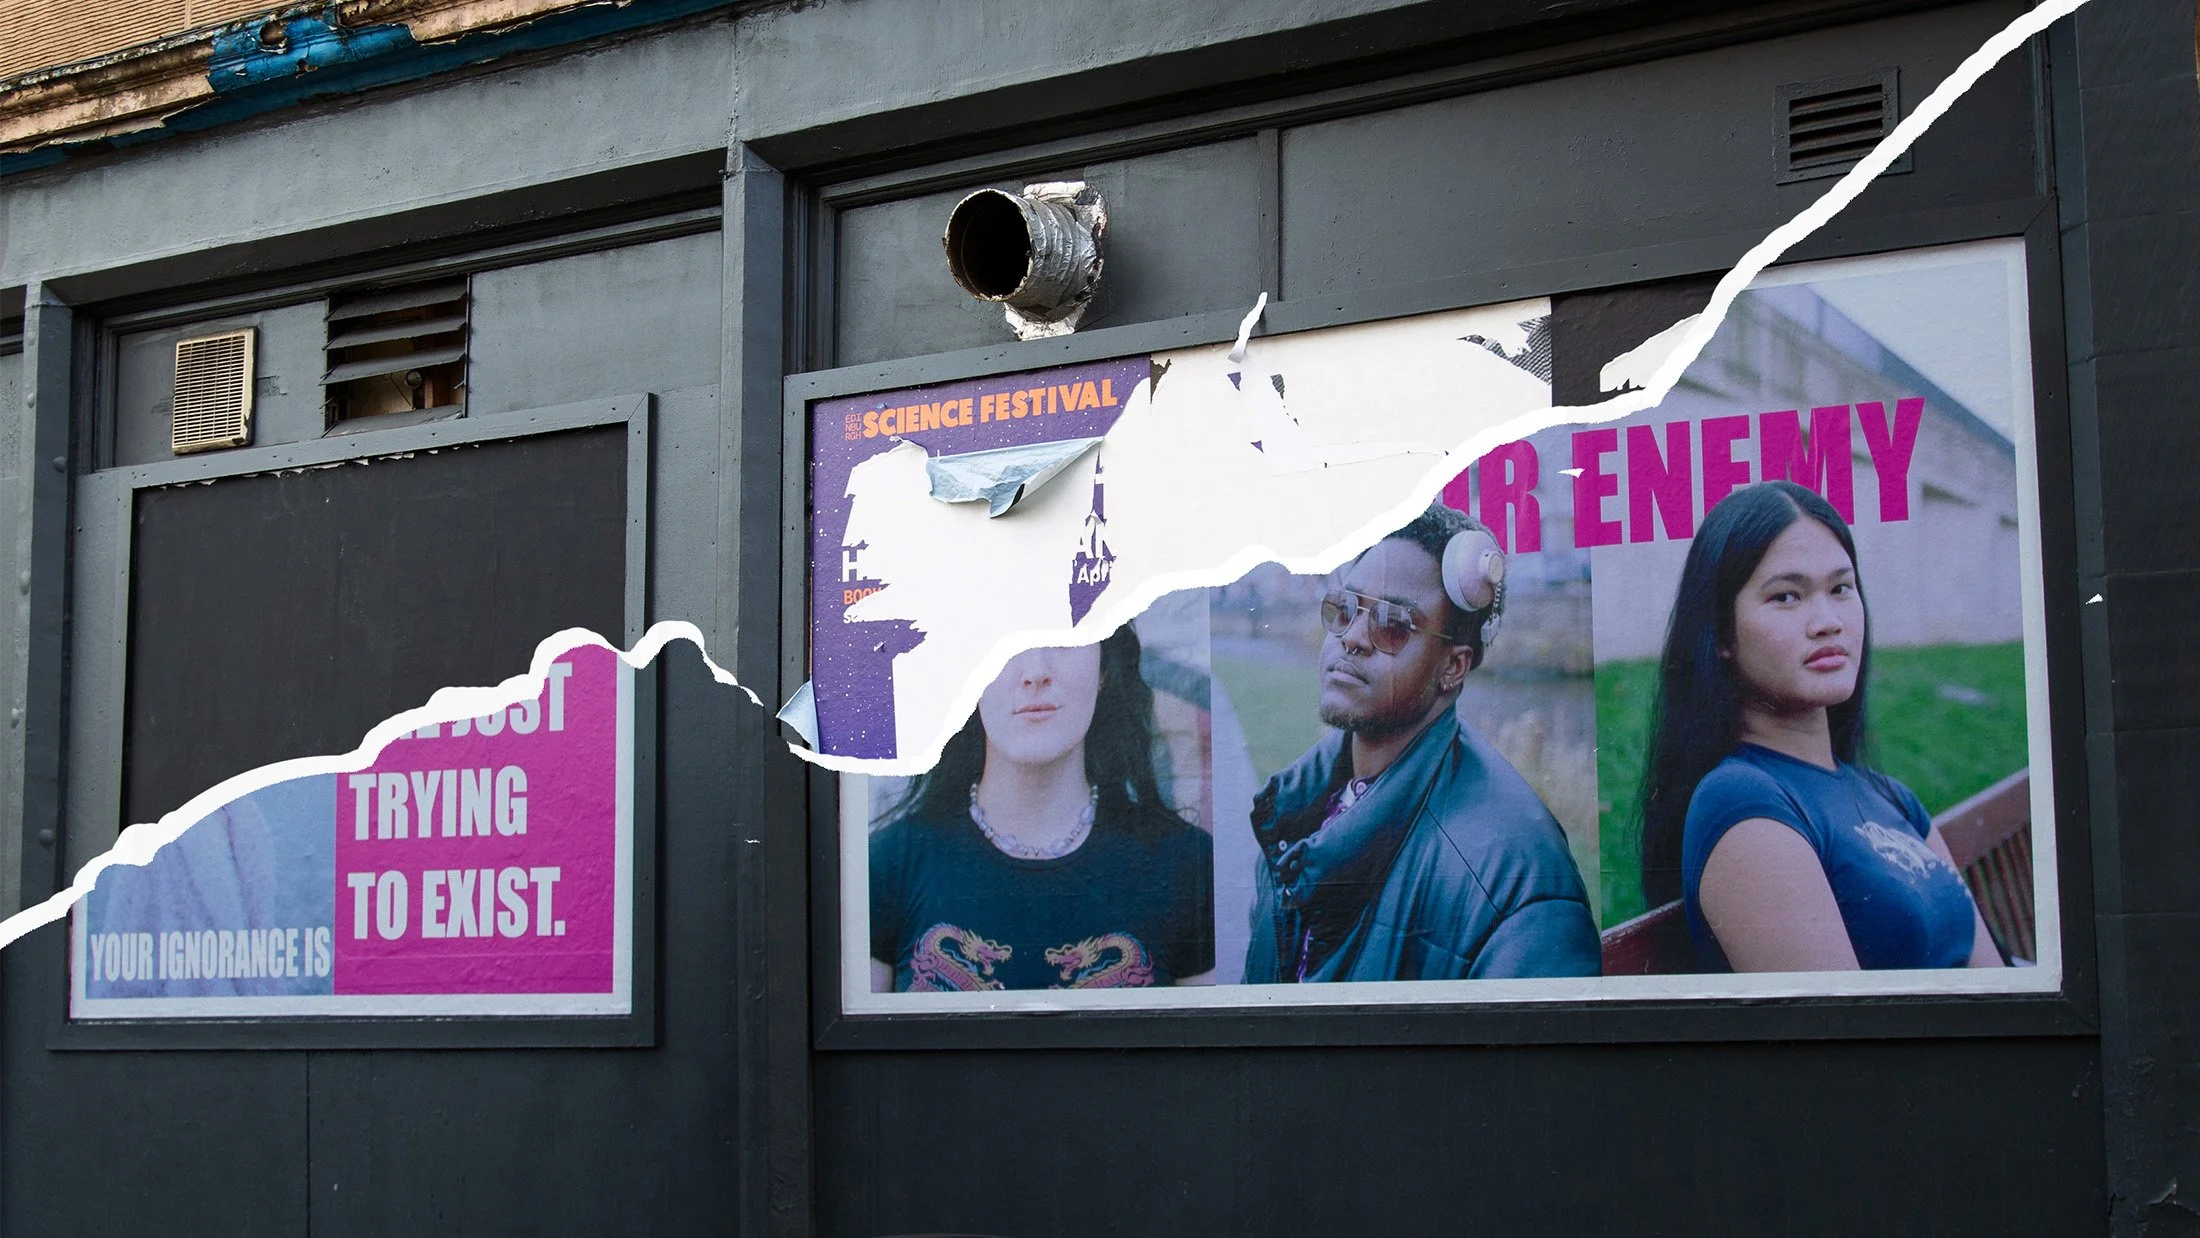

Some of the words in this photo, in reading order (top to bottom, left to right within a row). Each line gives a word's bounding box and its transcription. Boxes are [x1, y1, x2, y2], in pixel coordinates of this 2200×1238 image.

[863, 398, 973, 438] SCIENCE
[980, 379, 1118, 423] FESTIVAL
[1443, 439, 1542, 555] R
[1572, 397, 1926, 549] ENEMY
[348, 765, 528, 841] TRYING
[347, 871, 408, 941] TO
[421, 866, 567, 939] EXIST.
[91, 932, 154, 981] YOUR
[158, 928, 299, 980] IGNORANCE
[304, 926, 332, 978] IS
